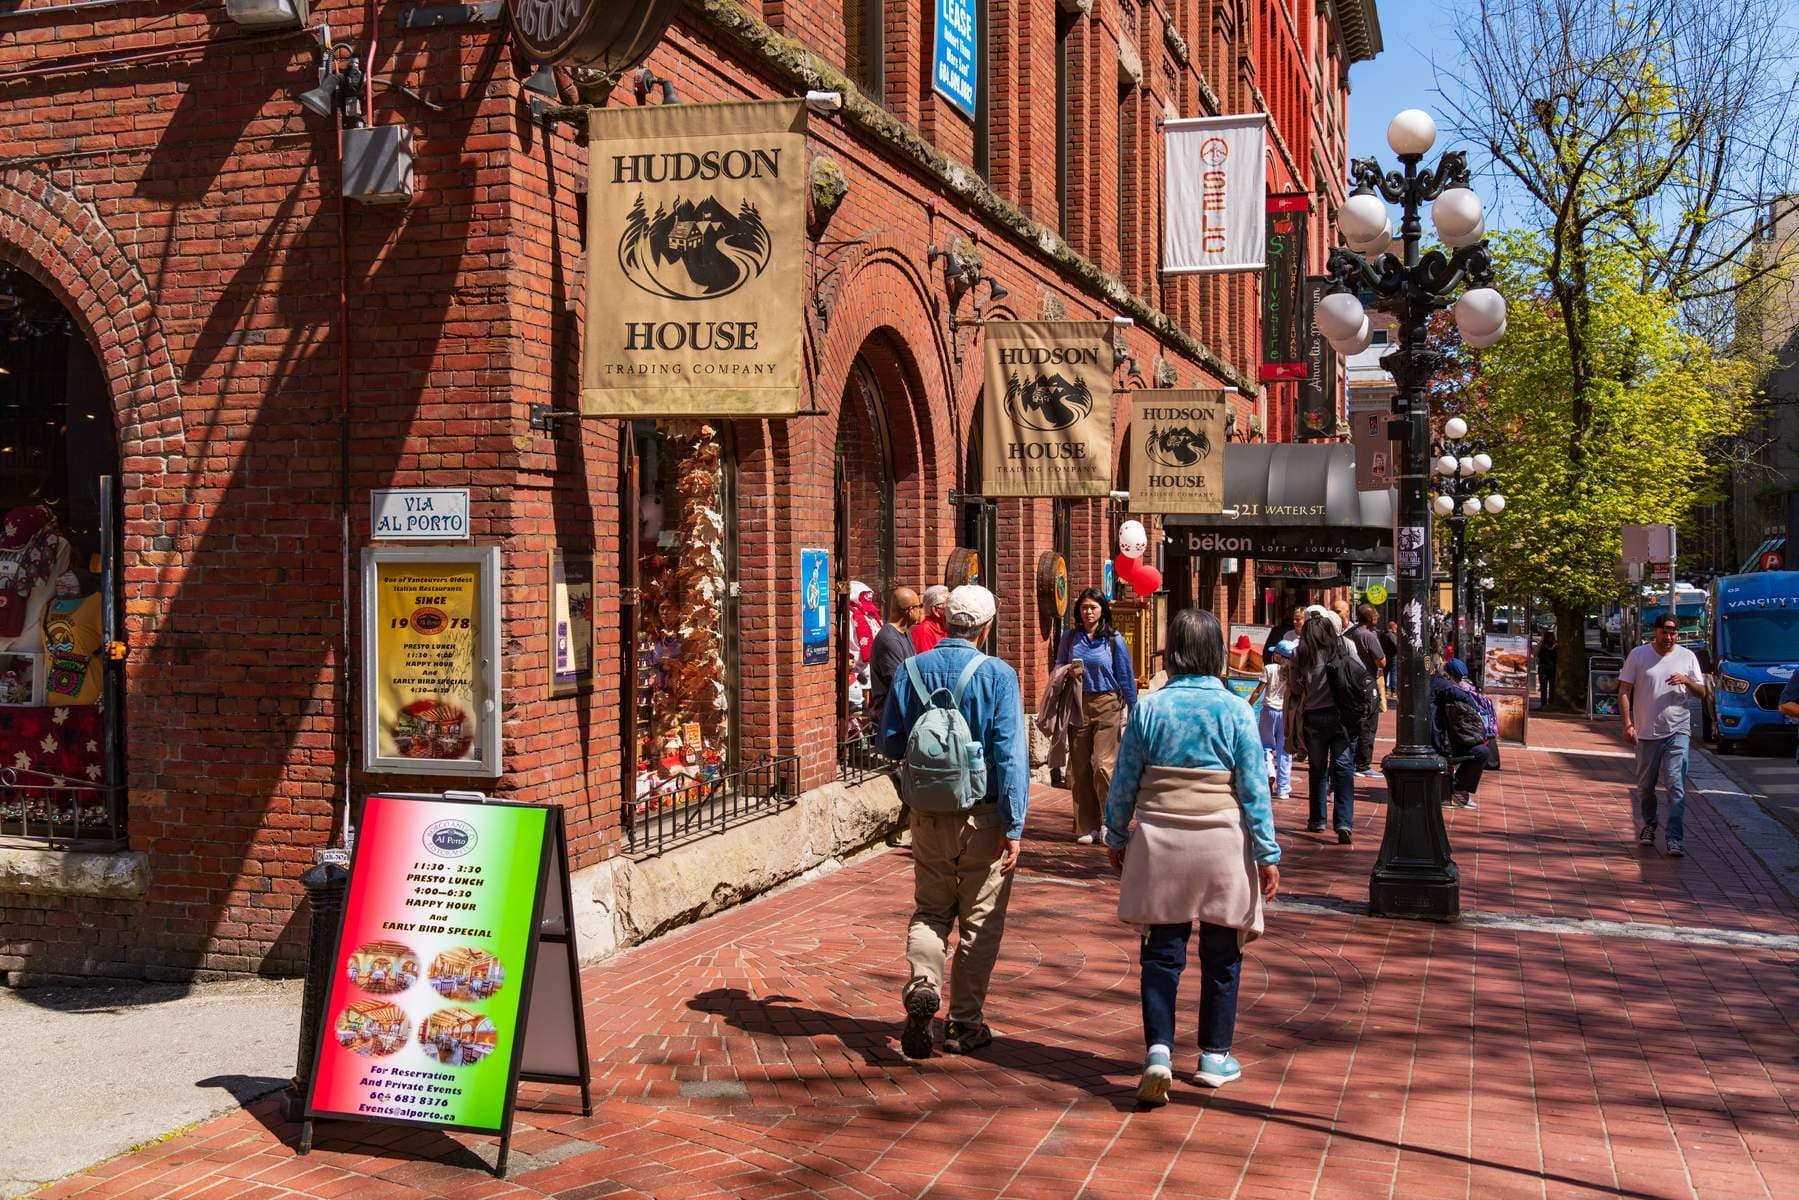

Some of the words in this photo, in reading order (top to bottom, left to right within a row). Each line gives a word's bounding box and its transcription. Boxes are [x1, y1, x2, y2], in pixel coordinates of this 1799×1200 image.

[943, 0, 972, 42] LEASE
[611, 148, 782, 184] HUDSON
[624, 321, 759, 351] HOUSE
[998, 347, 1100, 365] HUDSON
[605, 363, 681, 374] TRADING
[693, 363, 777, 375] COMPANY
[1143, 407, 1216, 420] HUDSON
[1007, 442, 1086, 459] HOUSE
[1148, 475, 1205, 488] HOUSE
[404, 496, 434, 512] VIA
[1231, 504, 1260, 520] 321
[1264, 505, 1308, 516] WATER
[377, 516, 402, 531] AL
[407, 514, 462, 531] PORTO
[1305, 545, 1348, 554] LOUNGE
[415, 596, 448, 605] SINCE
[1728, 597, 1787, 608] VANCITY
[434, 835, 445, 844] Al
[413, 862, 444, 872] 11:30
[456, 864, 483, 874] 3:30
[406, 873, 446, 884] PRESTO
[448, 876, 485, 887] LUNCH
[405, 899, 443, 909] HAPPY
[445, 901, 477, 911] HOUR
[429, 913, 448, 922] And
[382, 921, 417, 932] EARLY
[418, 924, 445, 934] BIRD
[447, 927, 493, 938] SPECIAL
[370, 1065, 388, 1075] For
[390, 1067, 456, 1082] Reservation
[359, 1077, 382, 1087] And
[384, 1080, 424, 1092] Private
[426, 1084, 463, 1096] Events
[394, 1094, 416, 1104] 683
[419, 1096, 449, 1107] 8376
